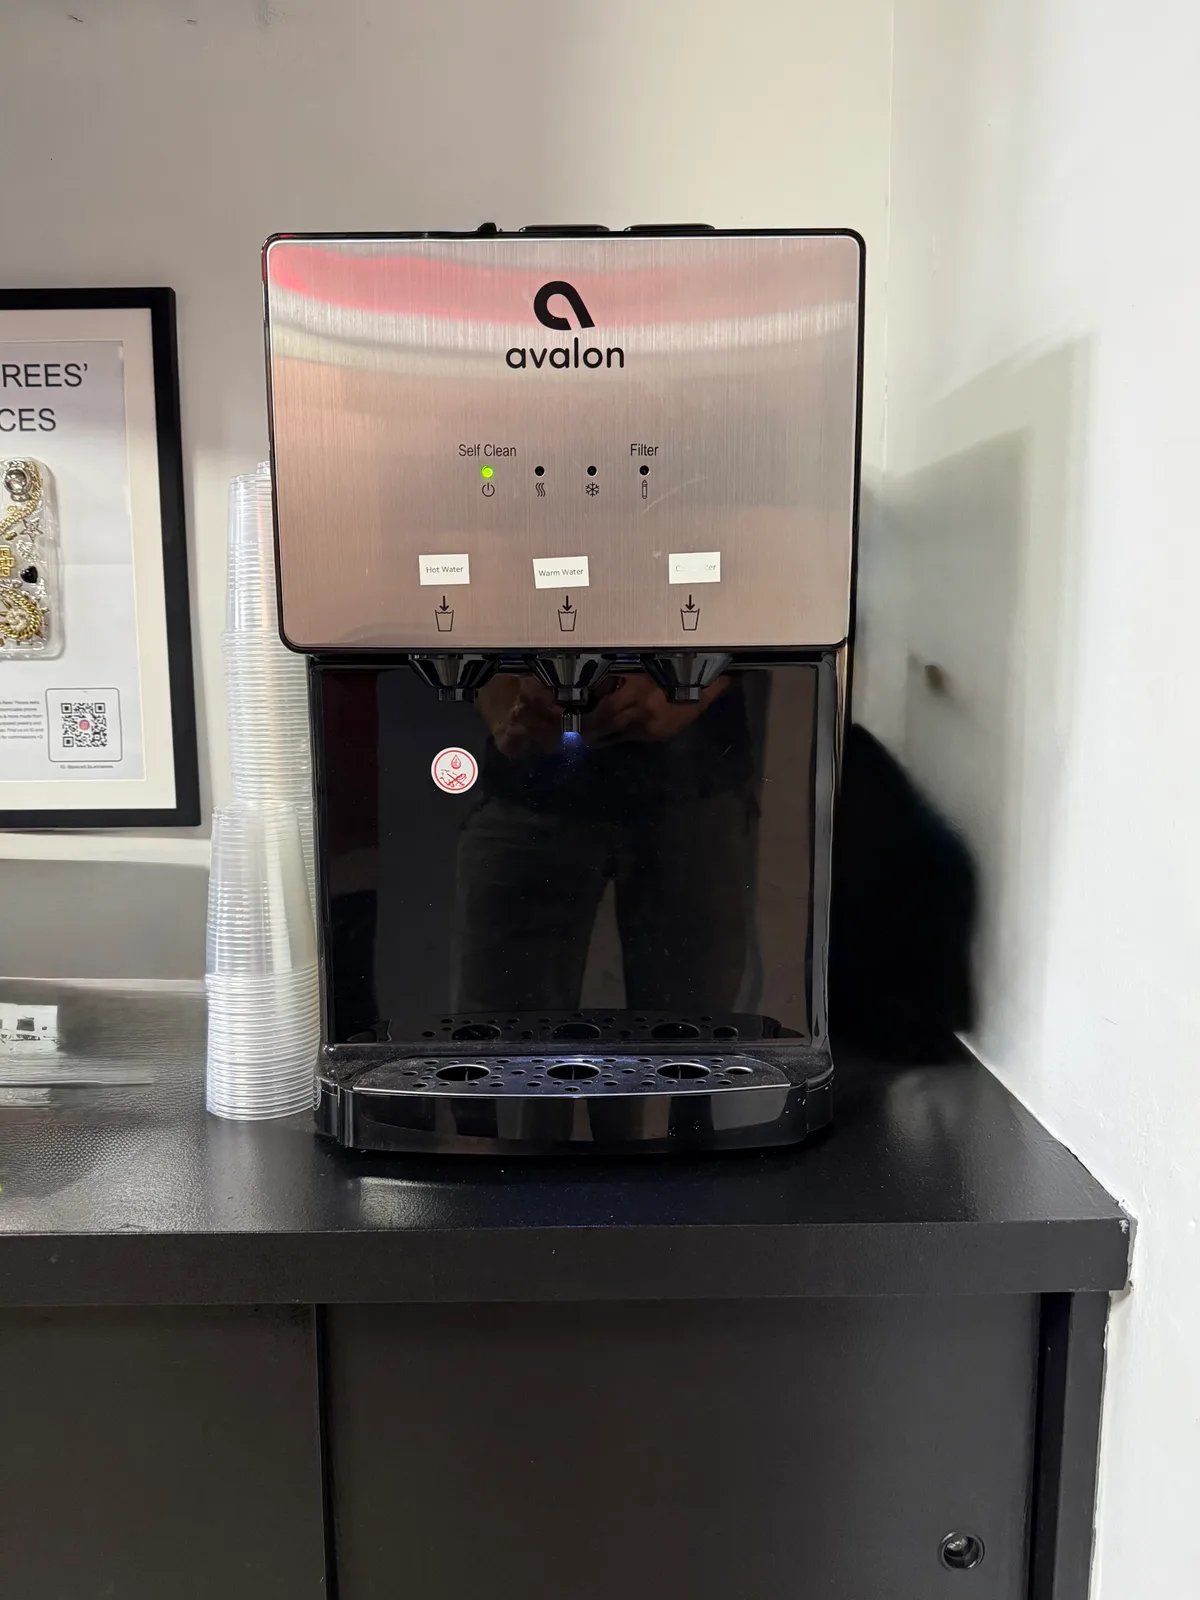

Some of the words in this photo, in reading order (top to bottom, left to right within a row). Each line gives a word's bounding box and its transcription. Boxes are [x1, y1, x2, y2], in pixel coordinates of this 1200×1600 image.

[505, 337, 625, 369] avalon
[458, 444, 481, 457] Self
[483, 444, 517, 457] Clean
[630, 443, 659, 456] Filter
[426, 566, 440, 574] Hot
[562, 568, 584, 576] Water
